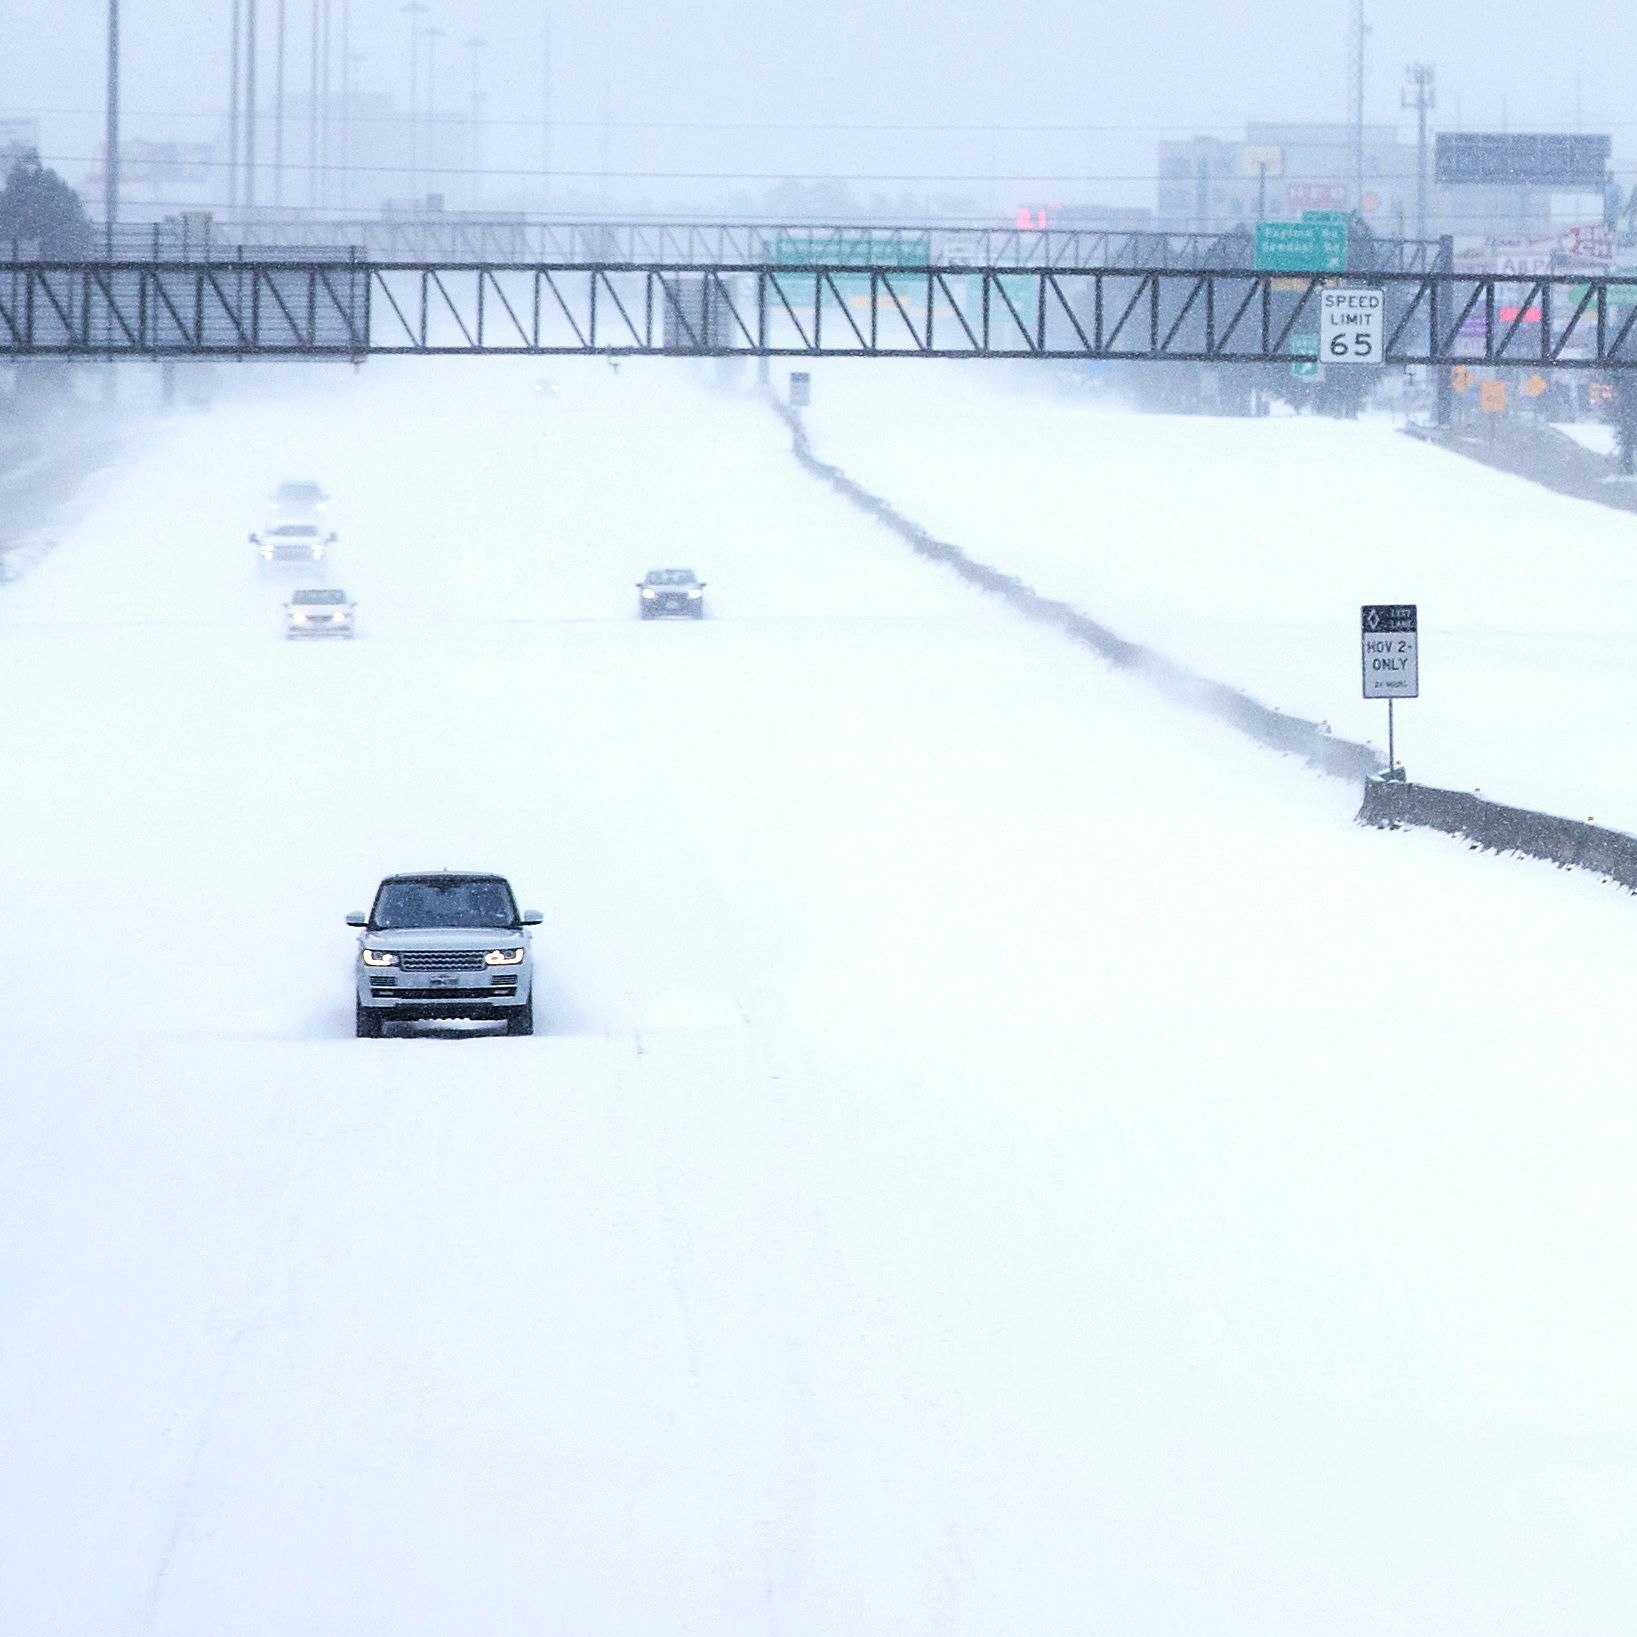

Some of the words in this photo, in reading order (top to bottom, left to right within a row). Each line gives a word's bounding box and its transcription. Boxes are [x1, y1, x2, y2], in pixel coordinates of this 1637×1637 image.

[1325, 295, 1379, 309] SPEED
[1331, 313, 1372, 325] LIMIT
[1330, 333, 1372, 357] 65
[1366, 640, 1393, 653] HOV
[1372, 658, 1408, 671] ONLY
